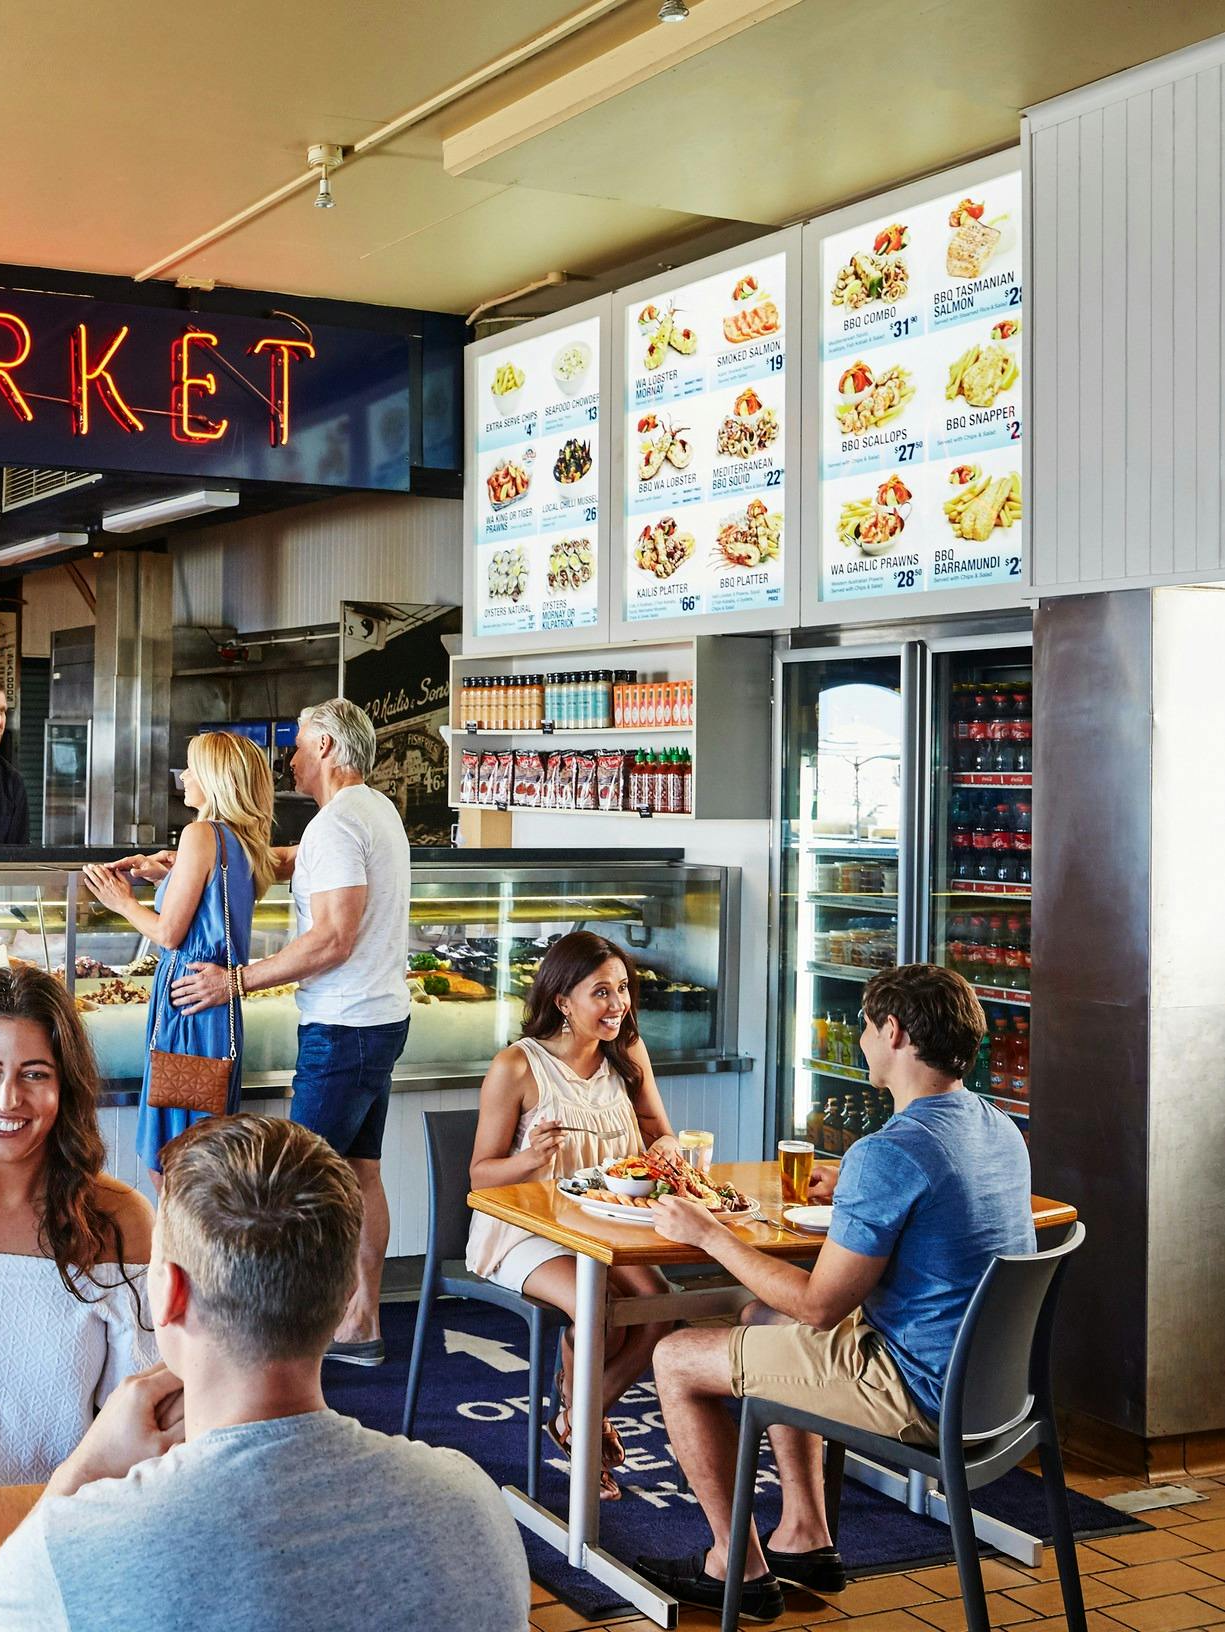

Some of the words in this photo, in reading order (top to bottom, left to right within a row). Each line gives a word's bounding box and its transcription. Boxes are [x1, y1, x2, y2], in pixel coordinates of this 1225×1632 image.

[934, 287, 953, 305] BBQ
[955, 271, 1015, 297] TASMANIAN
[934, 296, 974, 318] SALMON
[843, 316, 861, 331] BBQ
[864, 306, 896, 326] COMBO
[717, 349, 748, 368] SMOKED
[749, 340, 782, 359] SALMON
[636, 377, 647, 389] WA
[648, 369, 678, 386] LOBSTER
[636, 384, 664, 399] MORNAY
[545, 401, 571, 417] SEAFOOD
[946, 416, 966, 431] BBQ
[969, 405, 1015, 426] SNAPPER
[486, 418, 503, 433] EXTRA
[504, 415, 520, 428] SERVE
[522, 410, 538, 424] CHIPS
[842, 438, 860, 452] BBQ
[862, 428, 908, 449] SCALLOPS
[712, 457, 774, 478] MEDITERRANEAN
[638, 482, 653, 494] BBQ
[654, 479, 665, 490] WA
[666, 473, 697, 488] LOBSTER
[712, 478, 726, 490] BBQ
[728, 473, 750, 487] SQUID
[518, 507, 533, 518] TIGER
[542, 502, 559, 513] LOCAL
[486, 522, 508, 534] PRAWNS
[830, 564, 845, 576] WA
[847, 559, 878, 574] GARLIC
[880, 553, 919, 569] PRAWNS
[934, 549, 954, 562] BBQ
[934, 556, 1000, 575] BARRAMUNDI
[720, 577, 735, 589] BBQ
[736, 573, 769, 587] PLATTER
[636, 586, 658, 599] KAILIS
[659, 583, 688, 596] PLATTER
[484, 607, 507, 618] OYSTERS
[508, 604, 532, 615] NATURAL
[542, 600, 567, 611] OYSTERS
[542, 609, 566, 620] MORNAY
[542, 617, 574, 630] KILPATRICK
[417, 677, 449, 705] Sons
